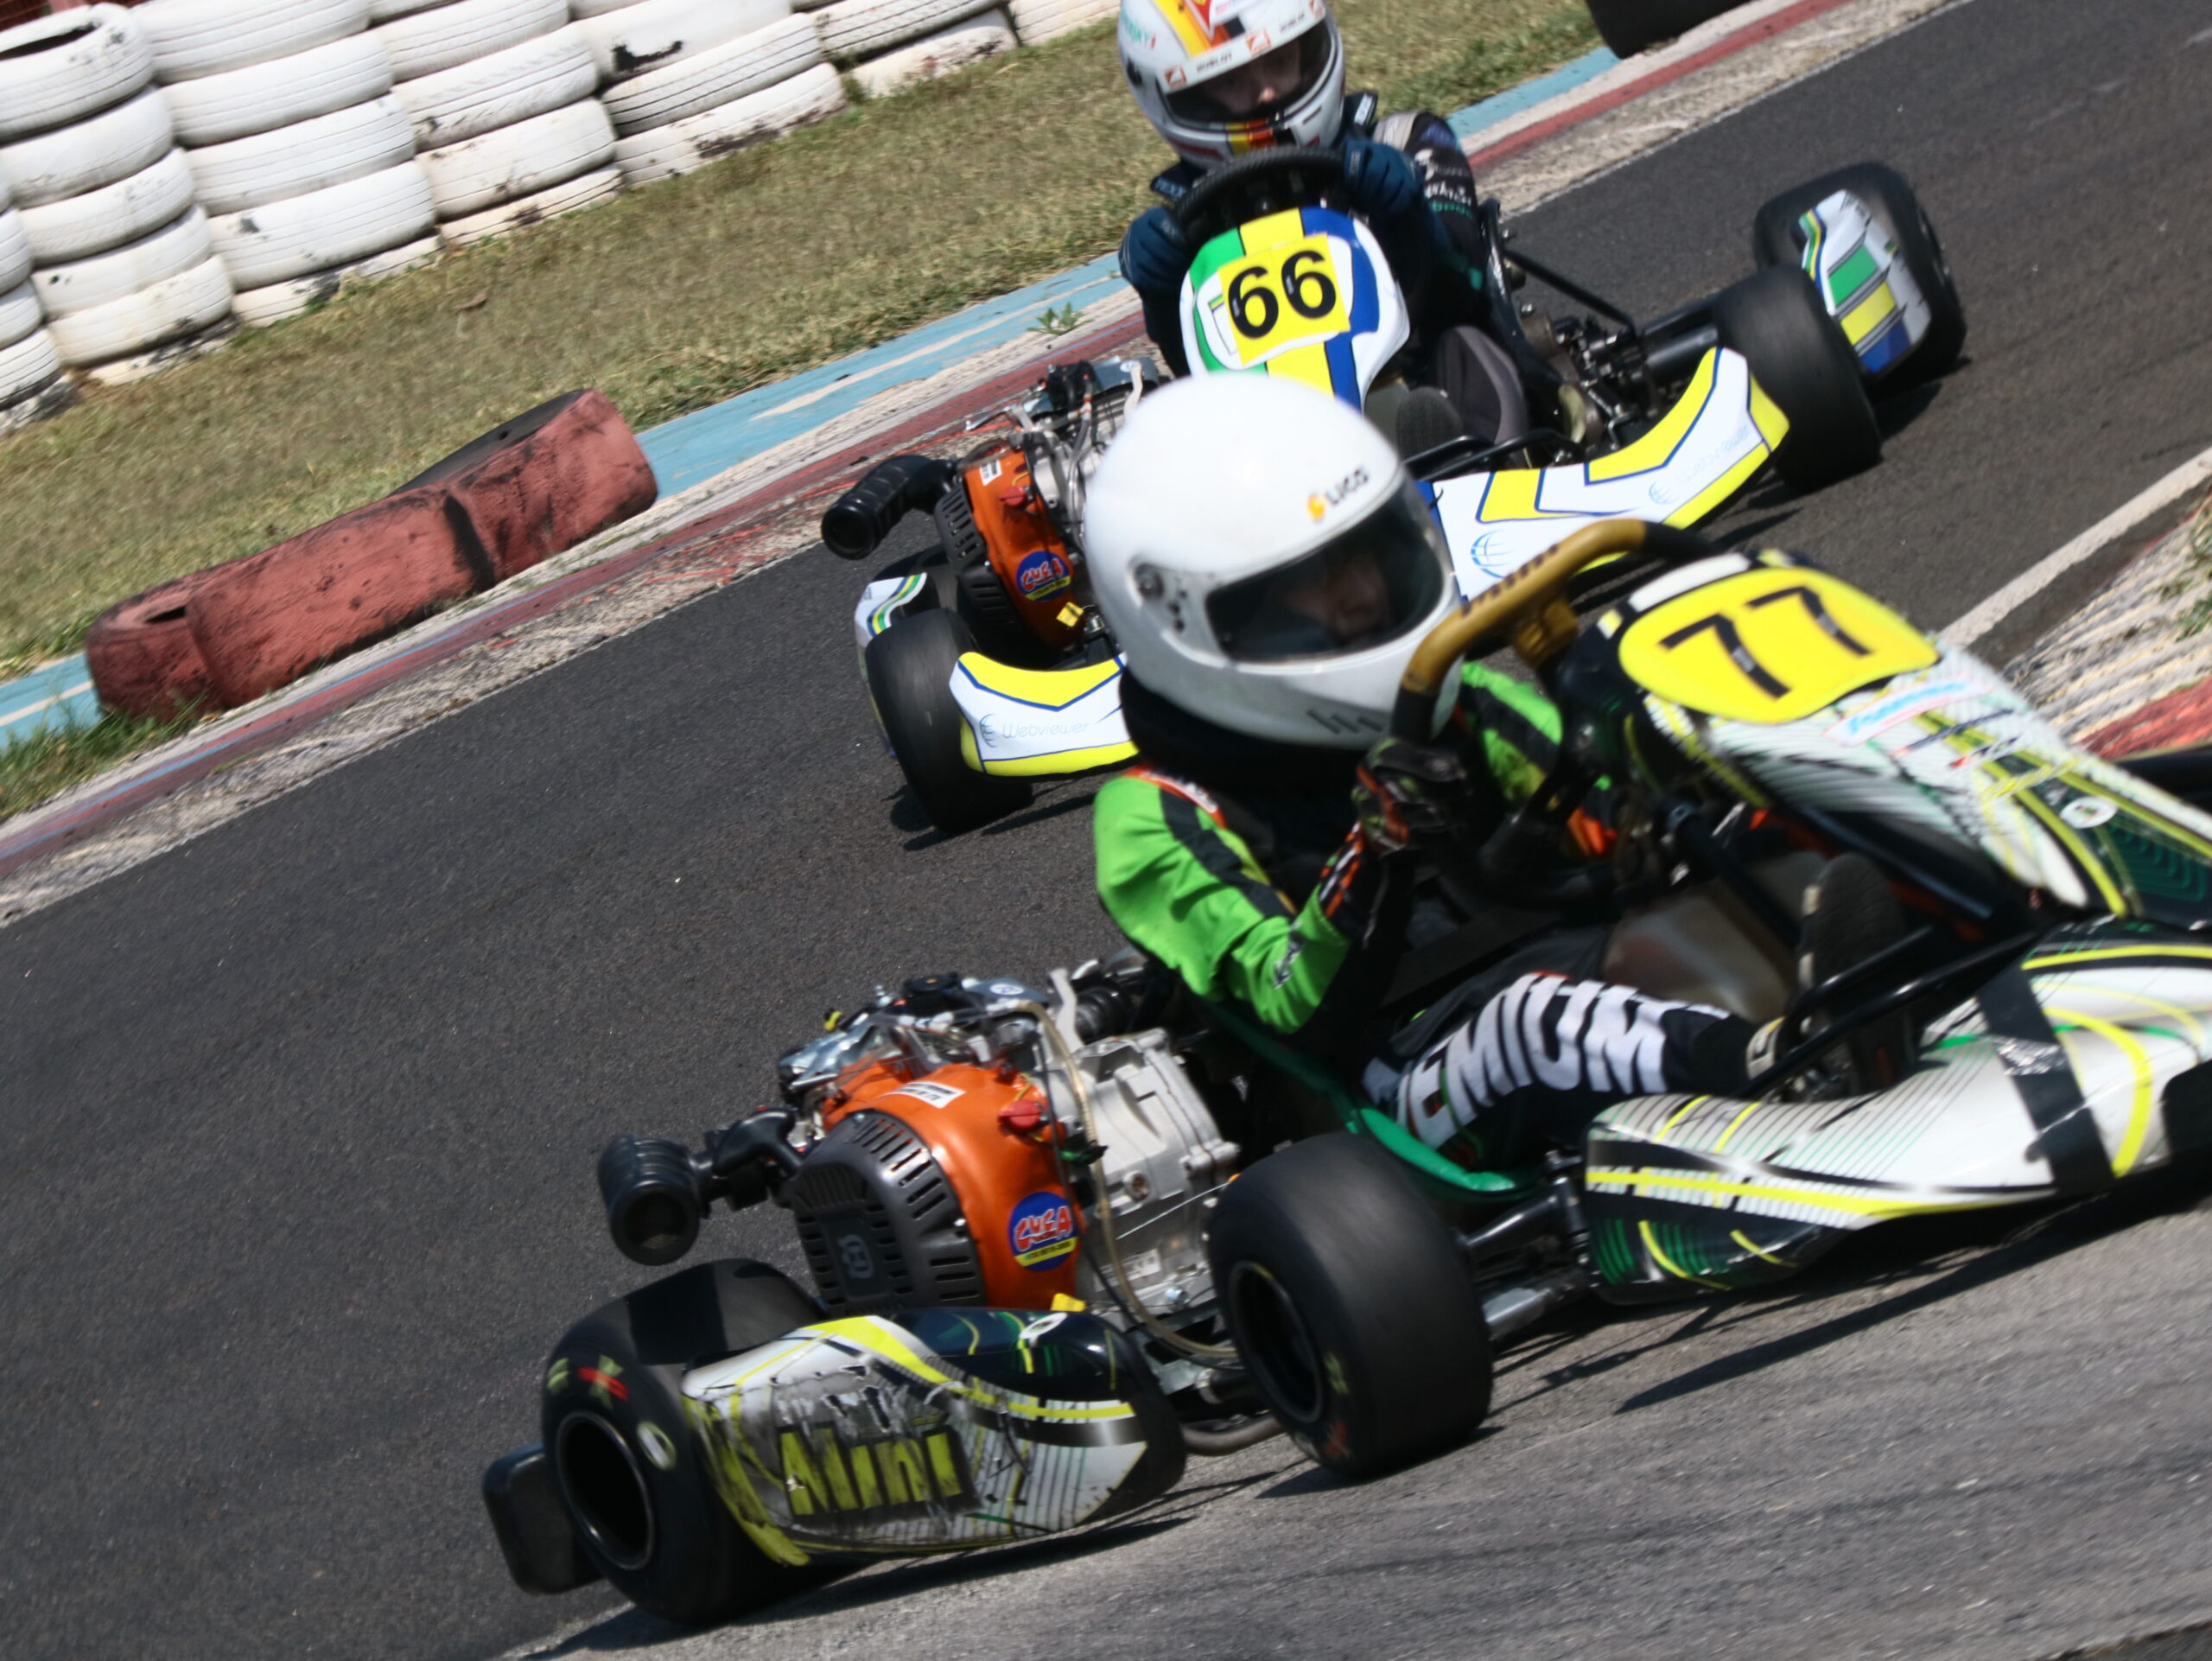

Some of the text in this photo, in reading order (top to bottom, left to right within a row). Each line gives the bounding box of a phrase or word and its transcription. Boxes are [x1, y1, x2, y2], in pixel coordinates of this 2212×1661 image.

[1226, 249, 1338, 339] 66
[1658, 585, 1873, 701] 77
[1001, 722, 1090, 740] Webviewer
